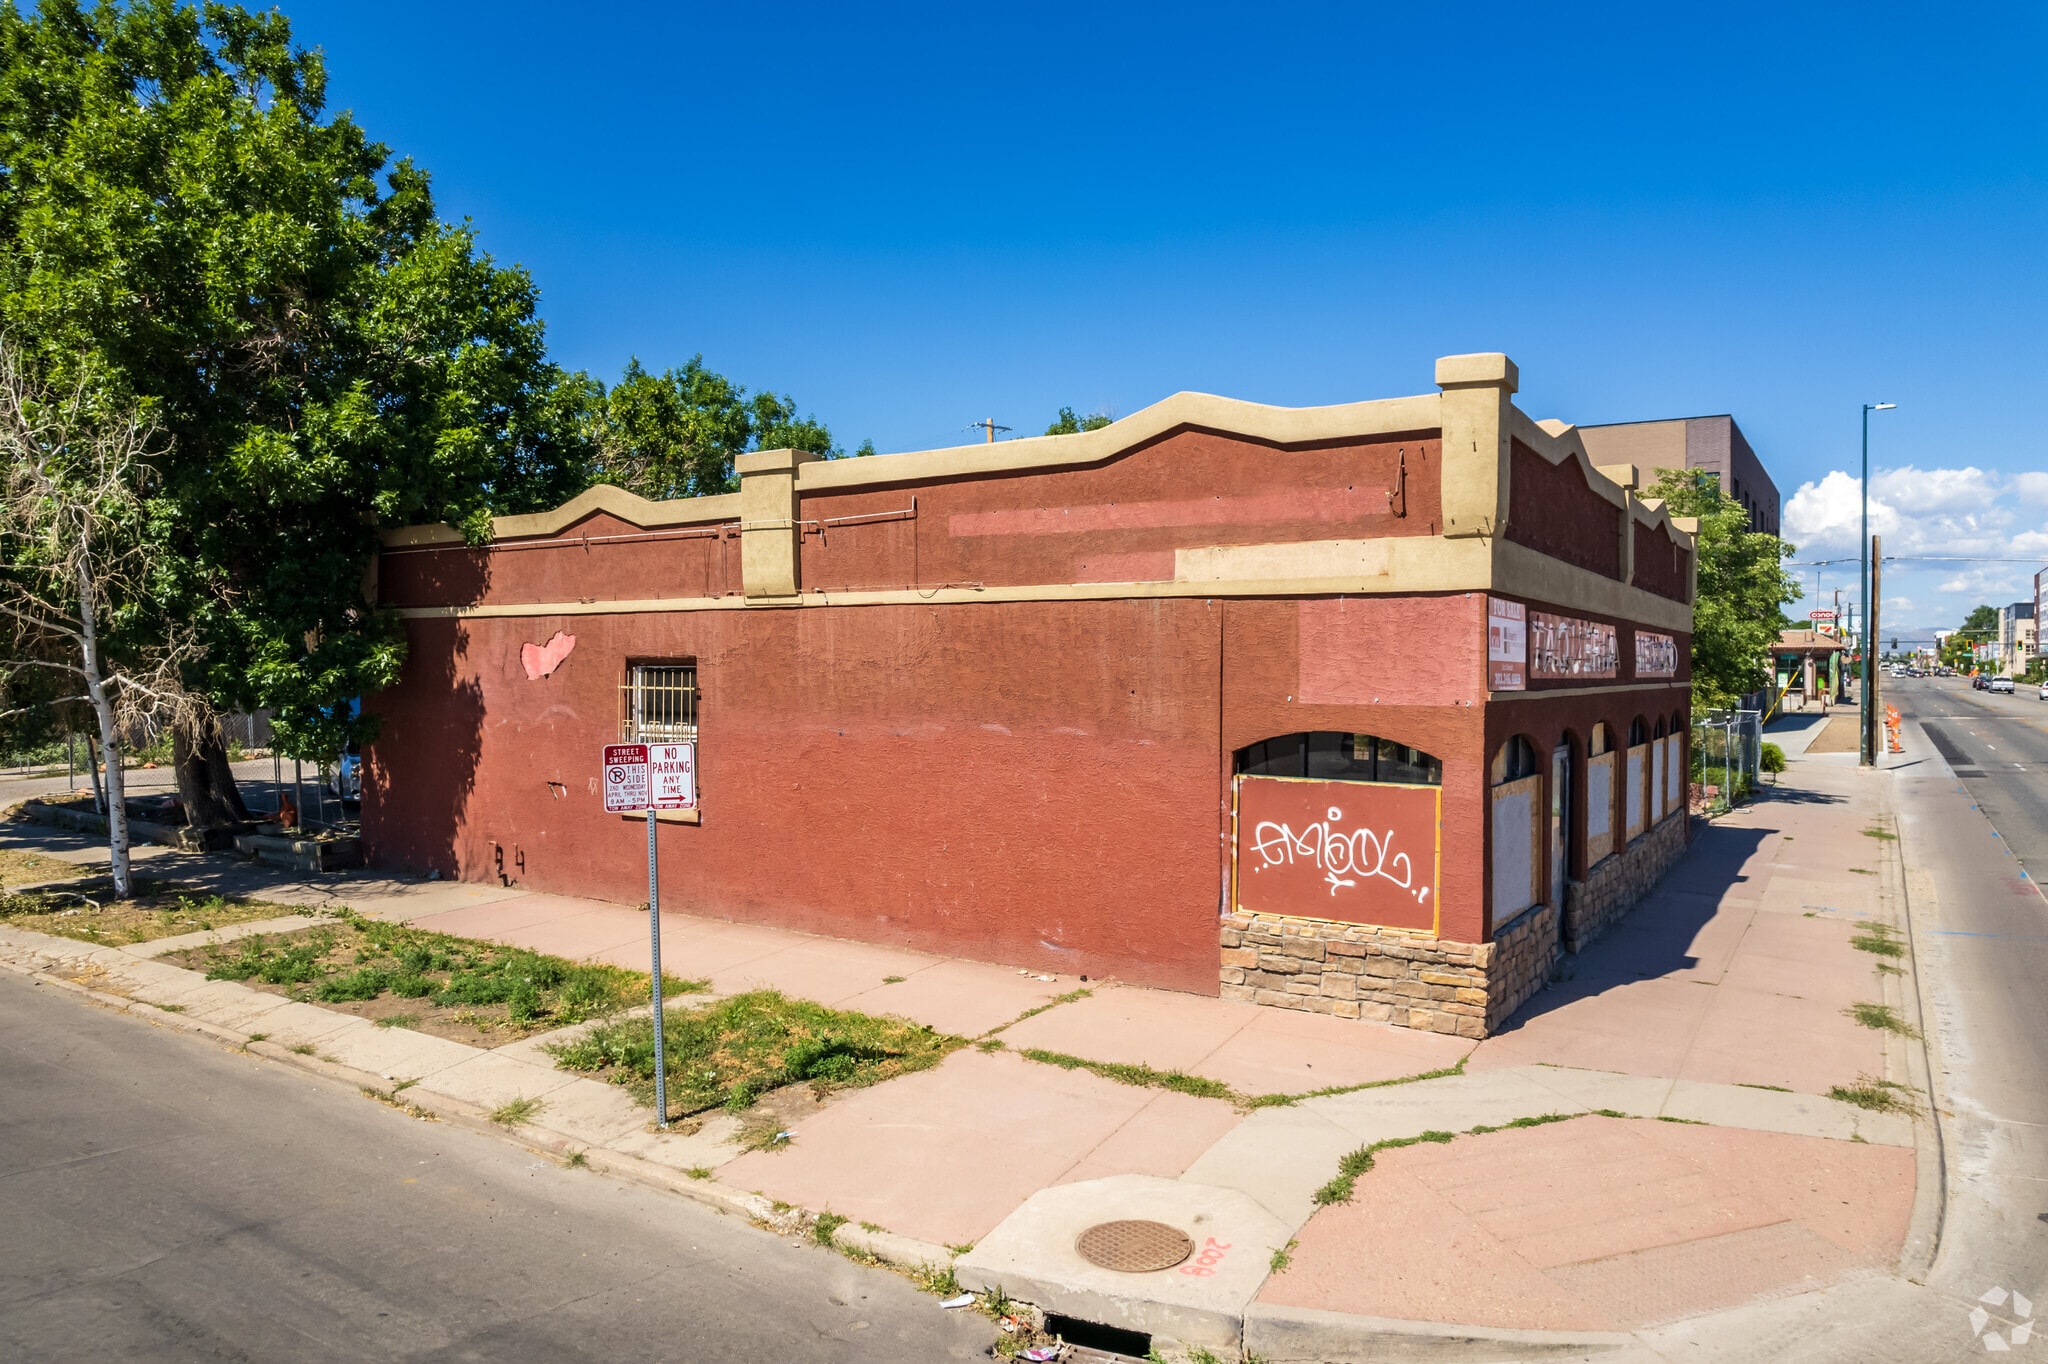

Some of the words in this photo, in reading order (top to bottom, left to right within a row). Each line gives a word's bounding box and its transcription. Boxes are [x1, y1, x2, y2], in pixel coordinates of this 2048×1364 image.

[1494, 599, 1506, 617] FOR
[1506, 601, 1520, 619] SALE
[613, 748, 640, 756] STREET
[664, 748, 677, 759] NO
[609, 756, 644, 764] SWEEPING
[627, 765, 645, 774] THIS
[653, 761, 690, 774] PARKING
[627, 774, 646, 784] SIDE
[663, 776, 680, 784] ANY
[663, 785, 681, 794] TIME
